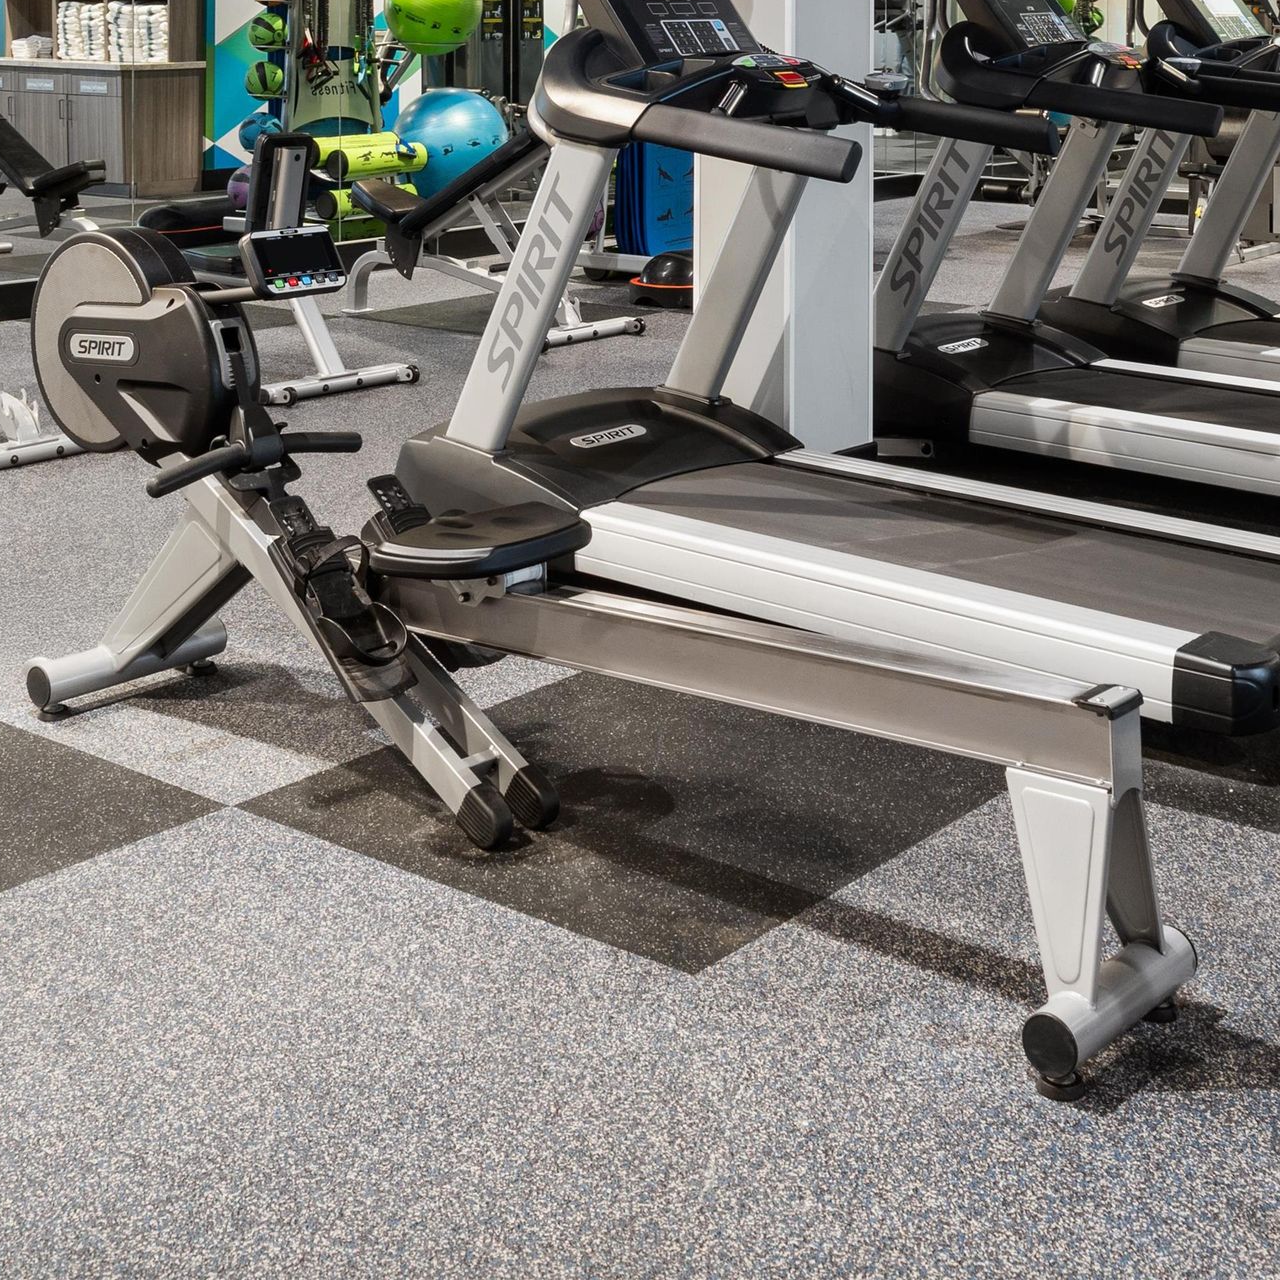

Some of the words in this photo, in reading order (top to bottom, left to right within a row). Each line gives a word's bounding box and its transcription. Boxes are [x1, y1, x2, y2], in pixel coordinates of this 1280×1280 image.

[890, 139, 970, 308] SPIRIT
[487, 171, 574, 394] SPIRIT
[78, 339, 125, 356] SPIRIT
[581, 426, 635, 445] SPIRIT
